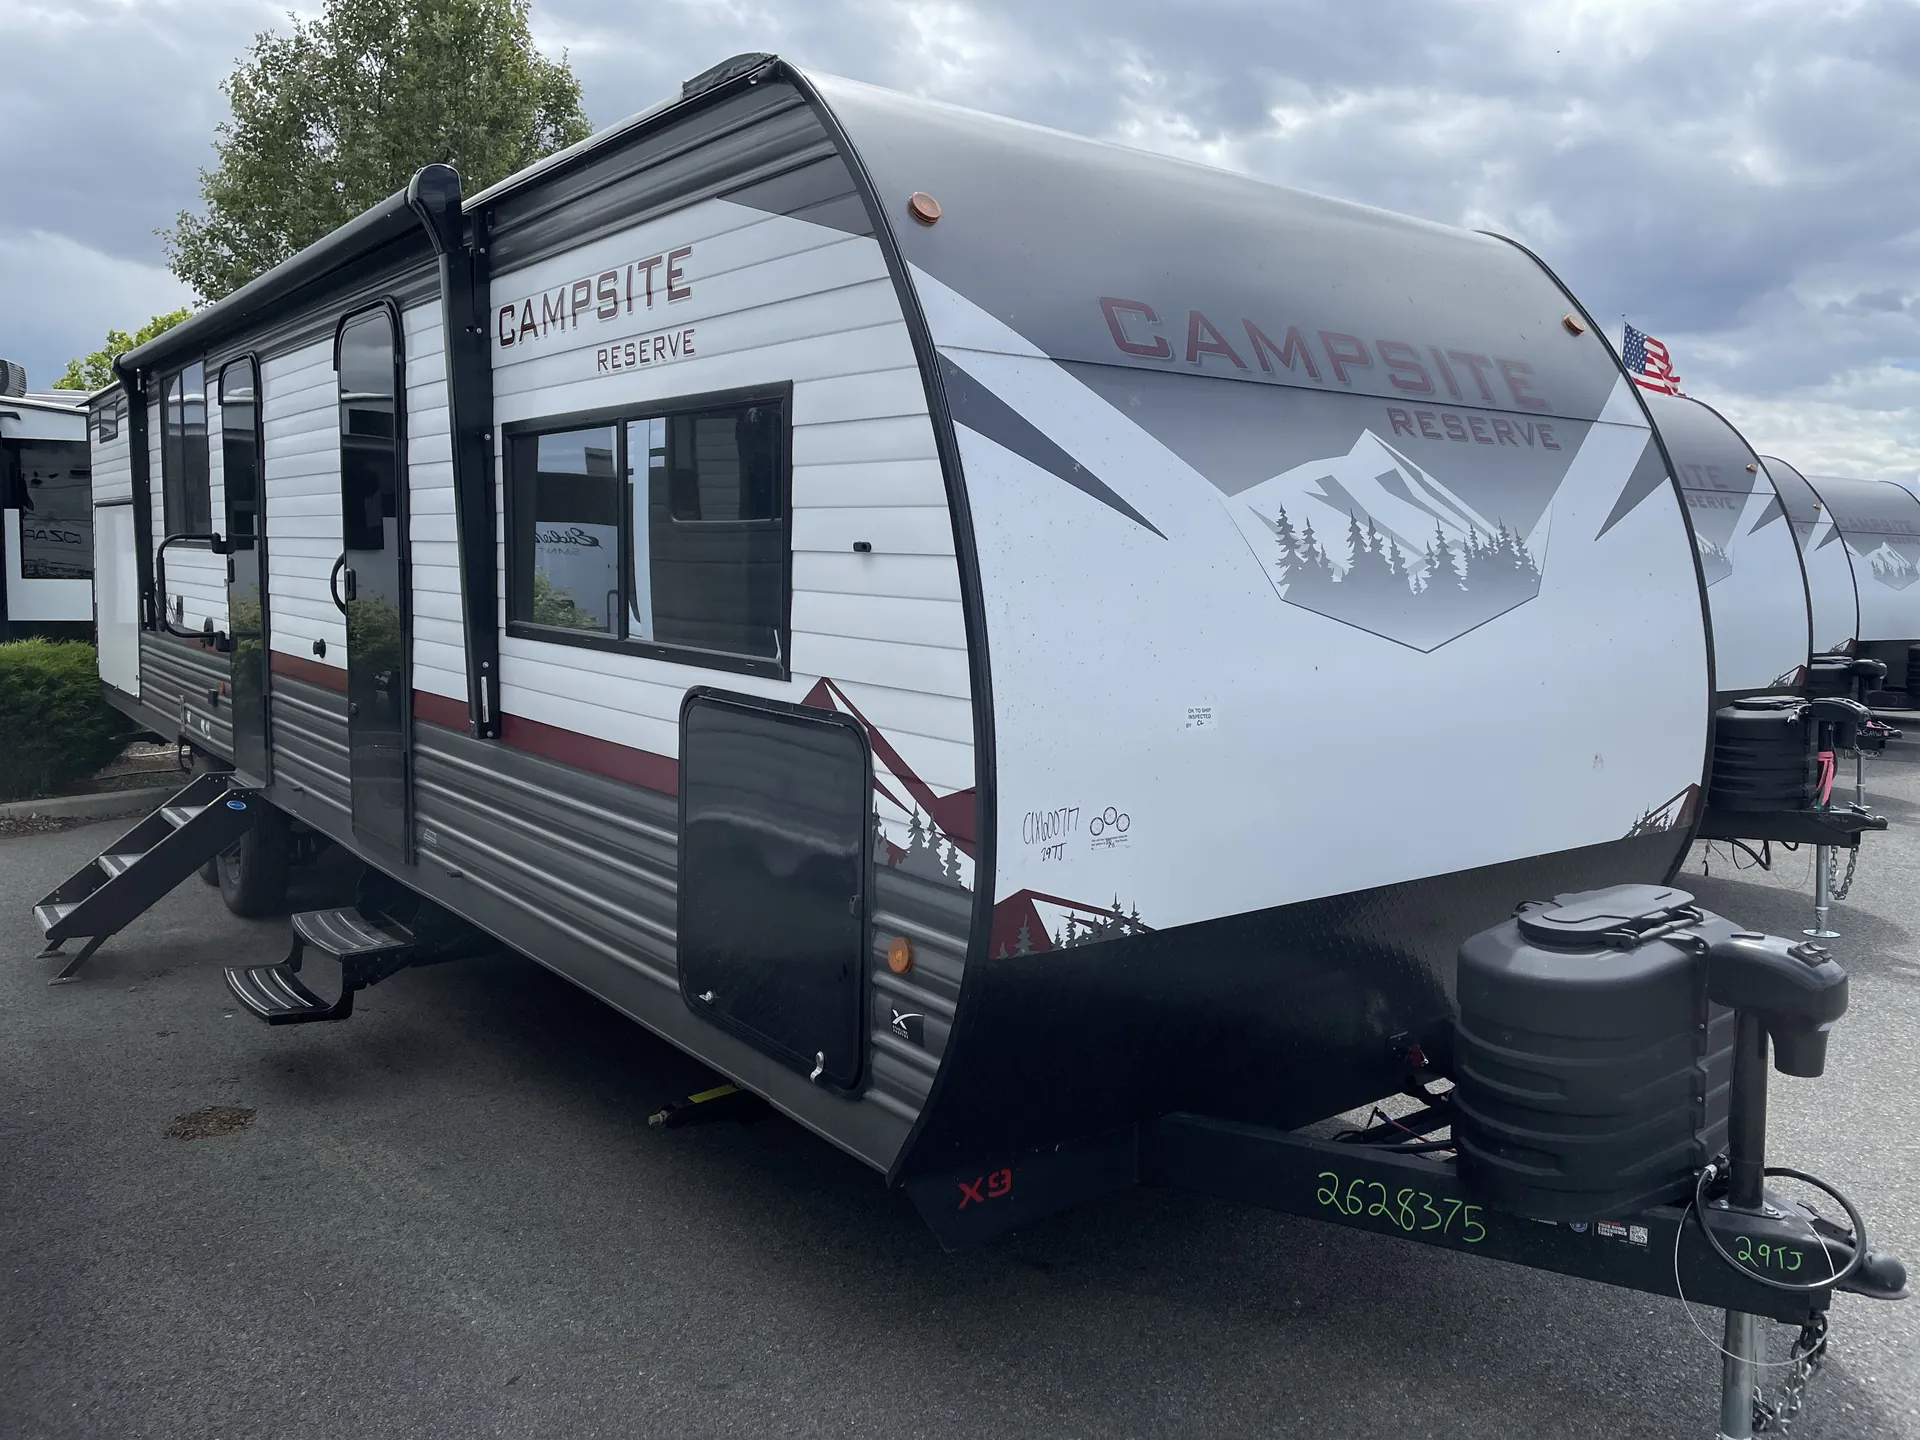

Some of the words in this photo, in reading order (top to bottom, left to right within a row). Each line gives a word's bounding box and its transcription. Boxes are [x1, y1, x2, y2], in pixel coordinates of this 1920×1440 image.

[499, 246, 692, 347] CAMPSITE
[597, 328, 695, 373] RESERVE
[1100, 296, 1551, 410] CAMPSITE
[1386, 405, 1561, 451] RESERVE
[1317, 1172, 1486, 1242] 2628375
[1735, 1236, 1803, 1271] 29TJ
